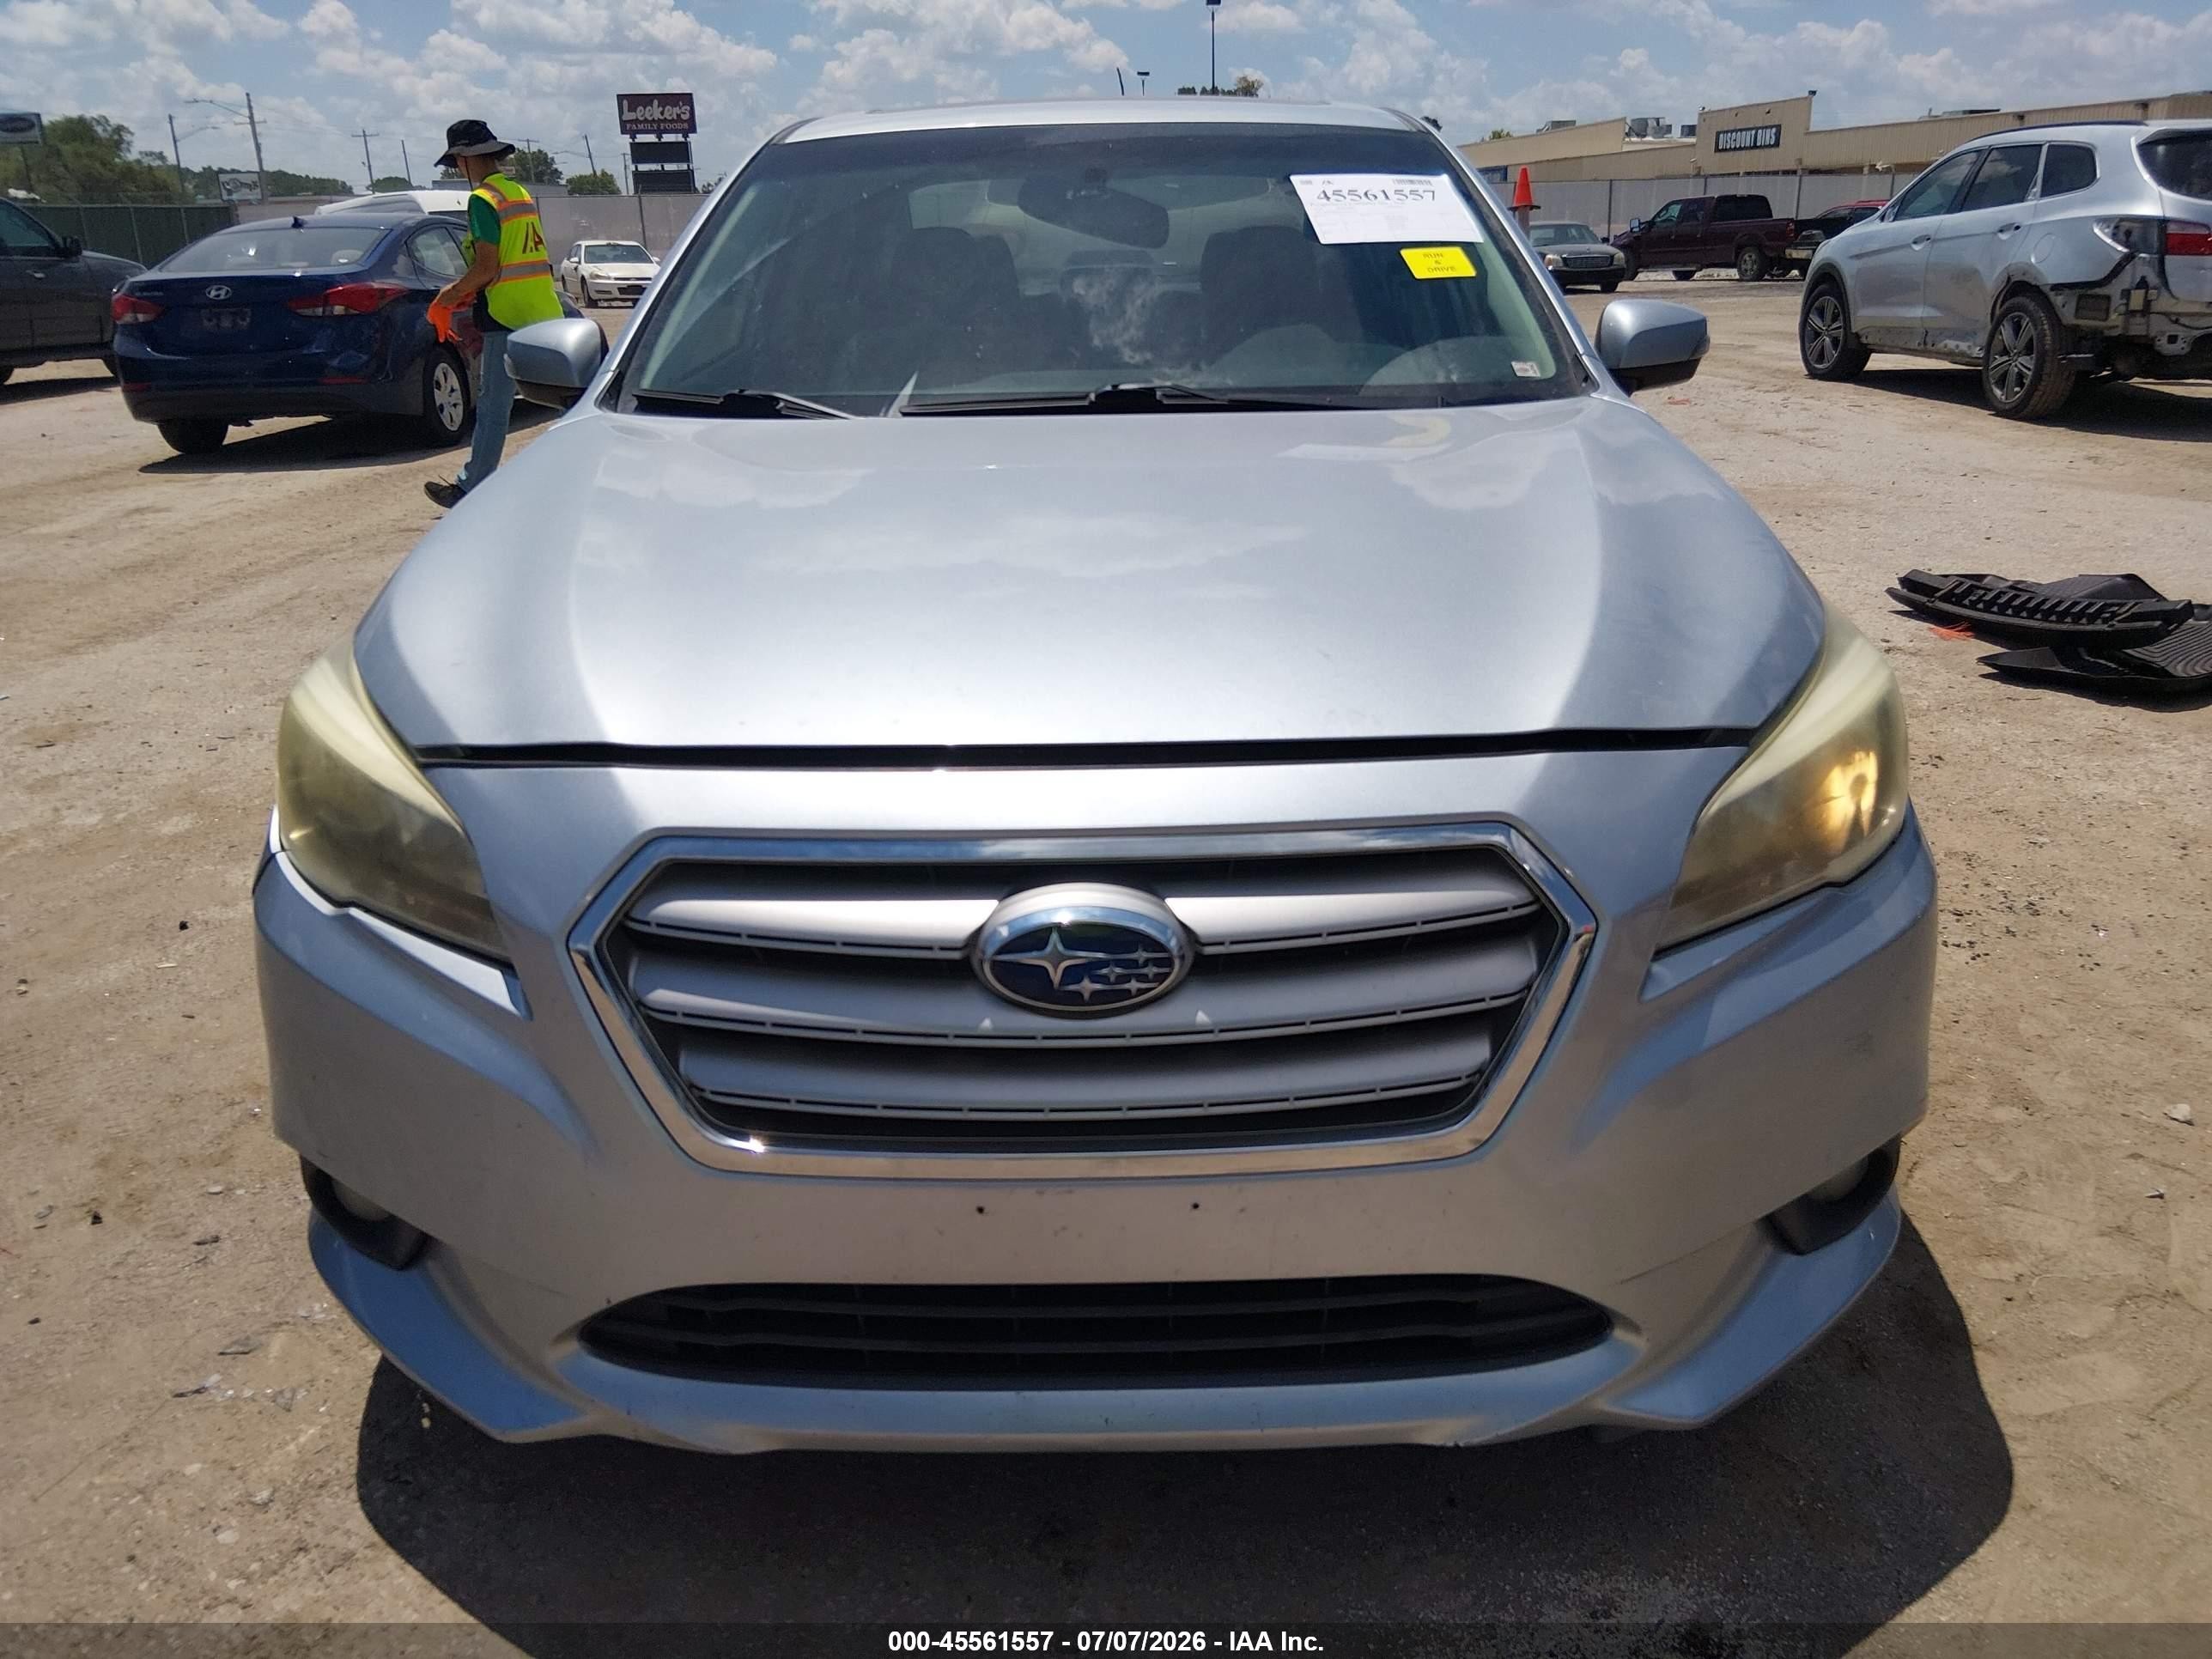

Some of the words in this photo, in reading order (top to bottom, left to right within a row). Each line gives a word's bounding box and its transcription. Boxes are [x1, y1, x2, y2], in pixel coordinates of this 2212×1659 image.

[622, 99, 690, 120] Leeker's
[1718, 130, 1756, 149] DISCOUNT
[1756, 127, 1777, 146] BINS
[1316, 188, 1436, 203] 45561557
